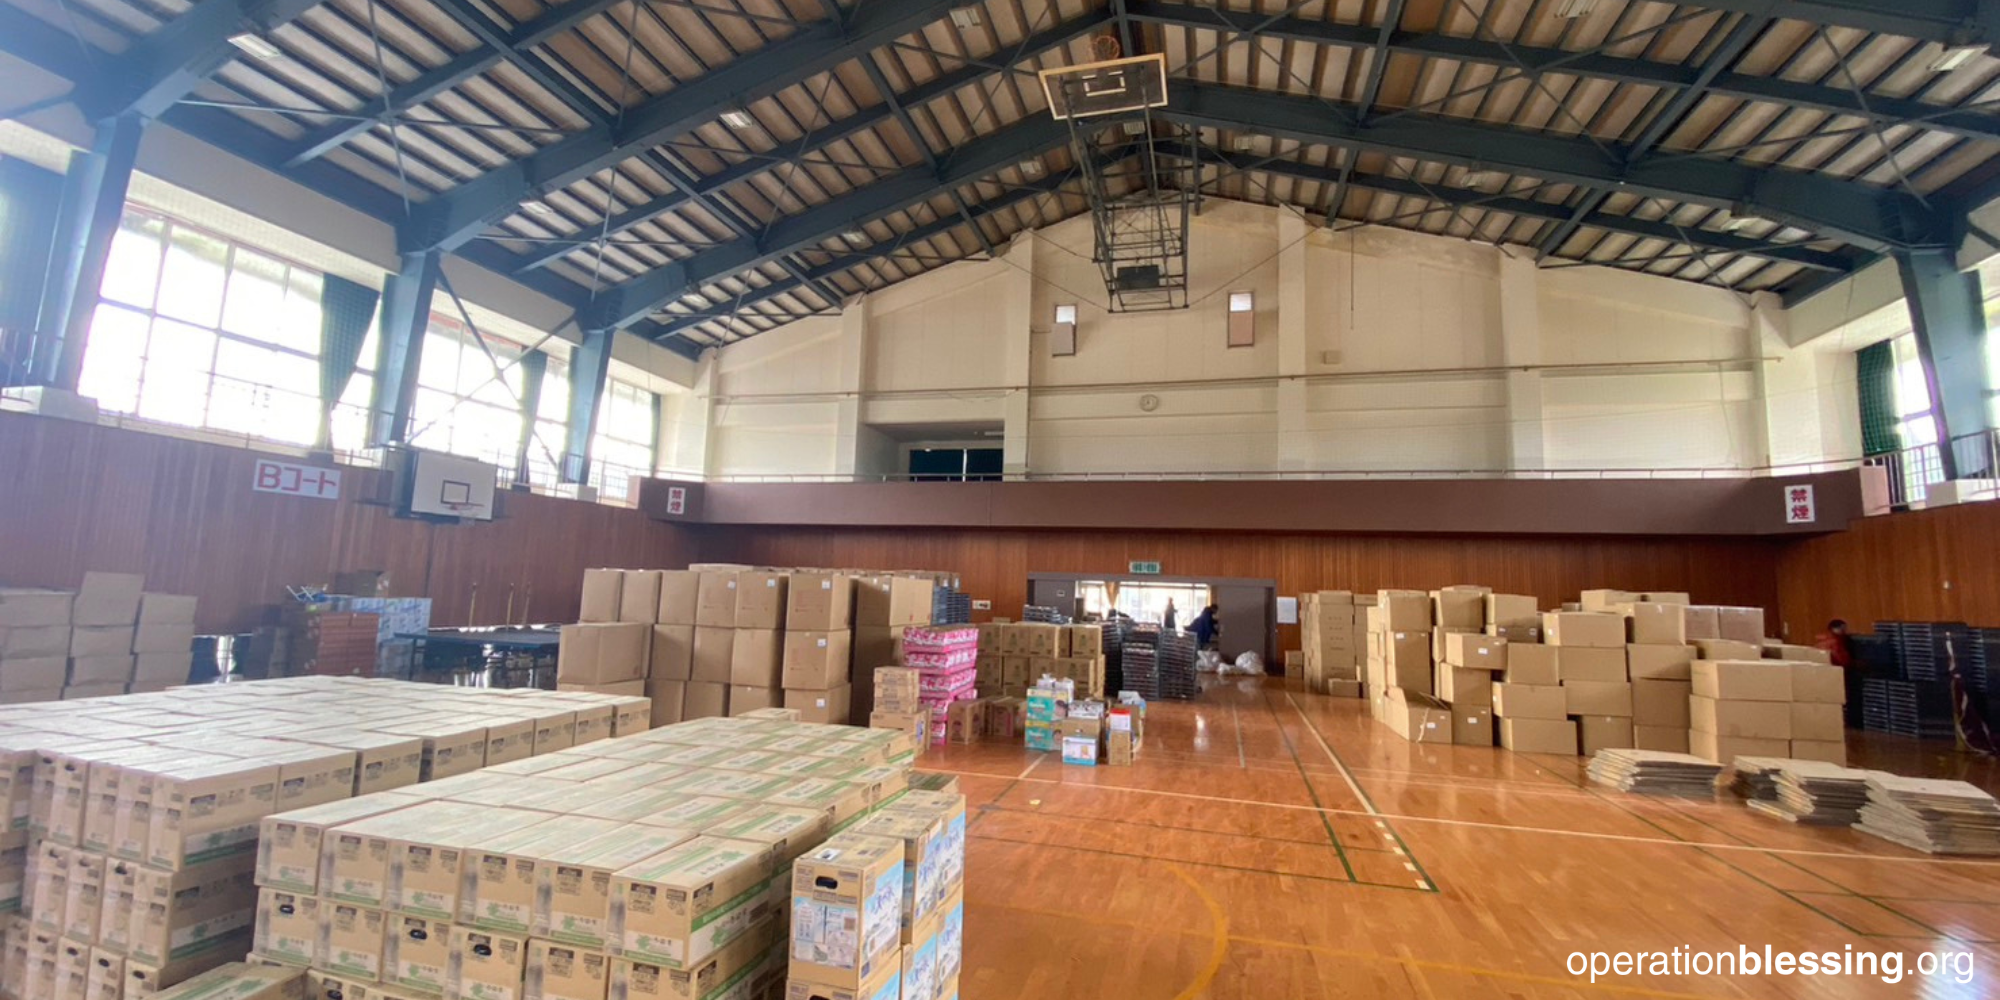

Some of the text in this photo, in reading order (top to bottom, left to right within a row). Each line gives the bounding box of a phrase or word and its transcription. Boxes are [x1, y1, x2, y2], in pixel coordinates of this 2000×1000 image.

[257, 463, 337, 495] Bコート
[1790, 488, 1809, 520] 禁煙
